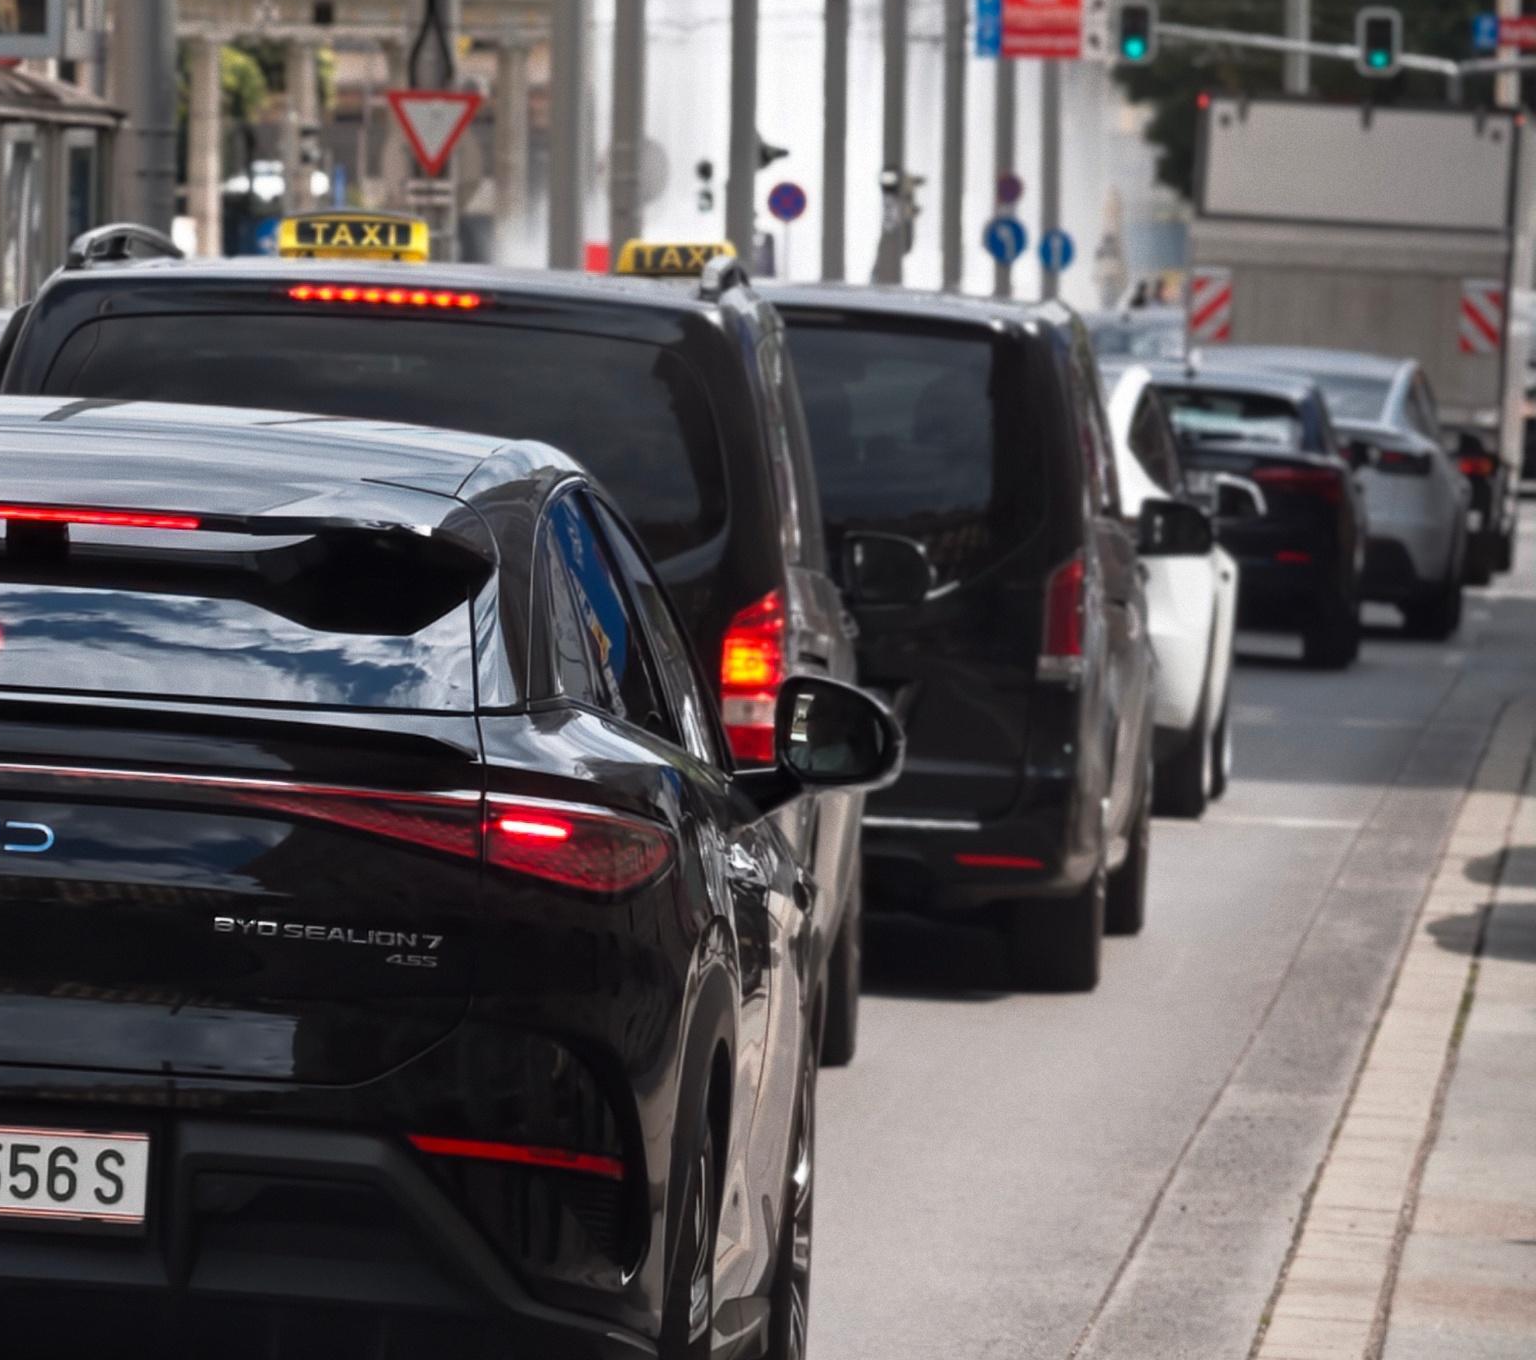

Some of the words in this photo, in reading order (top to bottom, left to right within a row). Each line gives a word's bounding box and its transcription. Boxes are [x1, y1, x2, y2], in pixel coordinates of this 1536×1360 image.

[312, 222, 398, 246] TAXI
[214, 917, 277, 936] BYD
[283, 923, 417, 947] SEALION
[422, 934, 443, 949] 7
